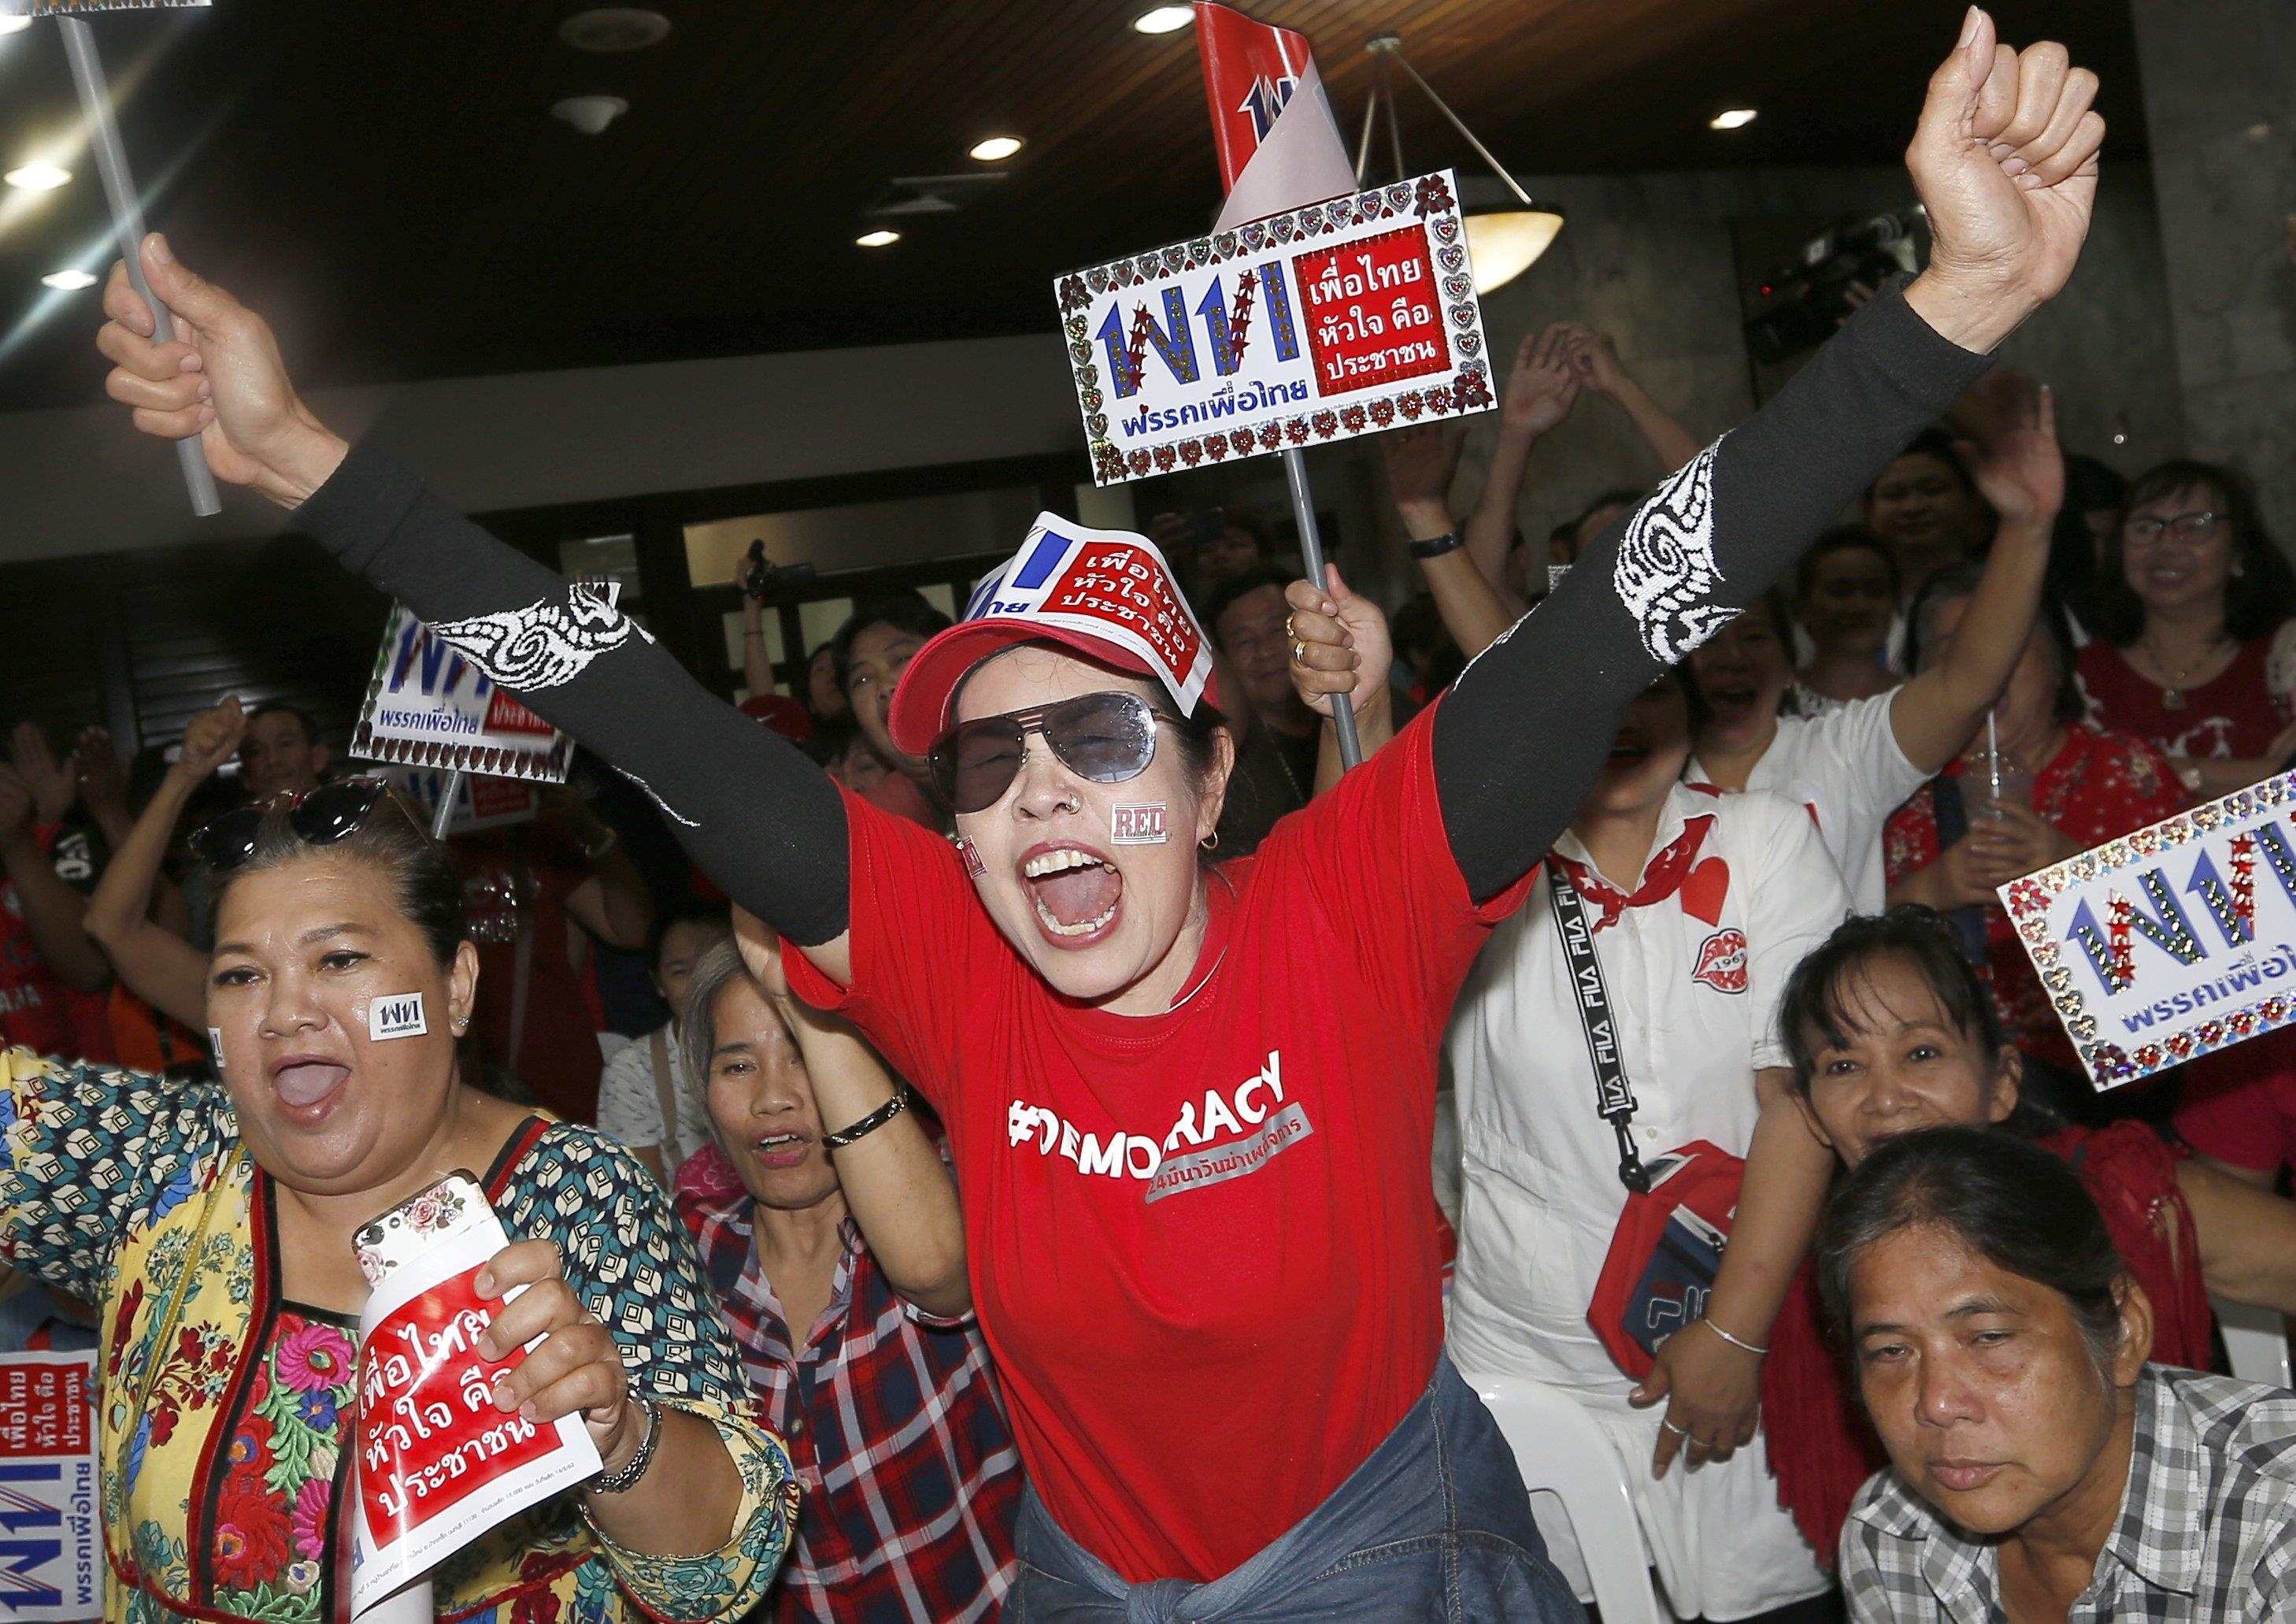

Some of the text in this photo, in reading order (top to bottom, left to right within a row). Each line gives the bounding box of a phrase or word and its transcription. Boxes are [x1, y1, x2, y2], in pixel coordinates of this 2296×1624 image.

[1309, 254, 1421, 306] เพื่อไทย
[1317, 300, 1431, 347] หัวใจ คือ
[1326, 340, 1436, 381] ประชาชน
[1121, 378, 1309, 438] พรรคเพื่อไทย
[1073, 573, 1150, 608] หัวใจ
[1157, 611, 1187, 653] คือ
[1087, 549, 1192, 636] เพื่อไทย
[1061, 591, 1178, 667] ประชาชน
[380, 706, 479, 734] พรรคเพื่อไทย
[1113, 807, 1166, 837] RED
[1565, 915, 1591, 956] FILA
[379, 1000, 420, 1025] พท
[1579, 965, 1605, 1008] FILA
[1592, 1020, 1616, 1064] FILA
[1009, 1049, 1284, 1180] #DEMORACY
[1605, 1075, 1628, 1107] ILA
[359, 1309, 491, 1420] เพื่อไทย
[1, 1370, 27, 1450] เพื่อไทย
[32, 1403, 57, 1448] หัวใจ
[61, 1371, 82, 1446] ประชาชน
[365, 1395, 453, 1472] หัวใจ
[378, 1415, 535, 1518] ประชาชน
[66, 1462, 93, 1606] พรรคเพื่อไทย
